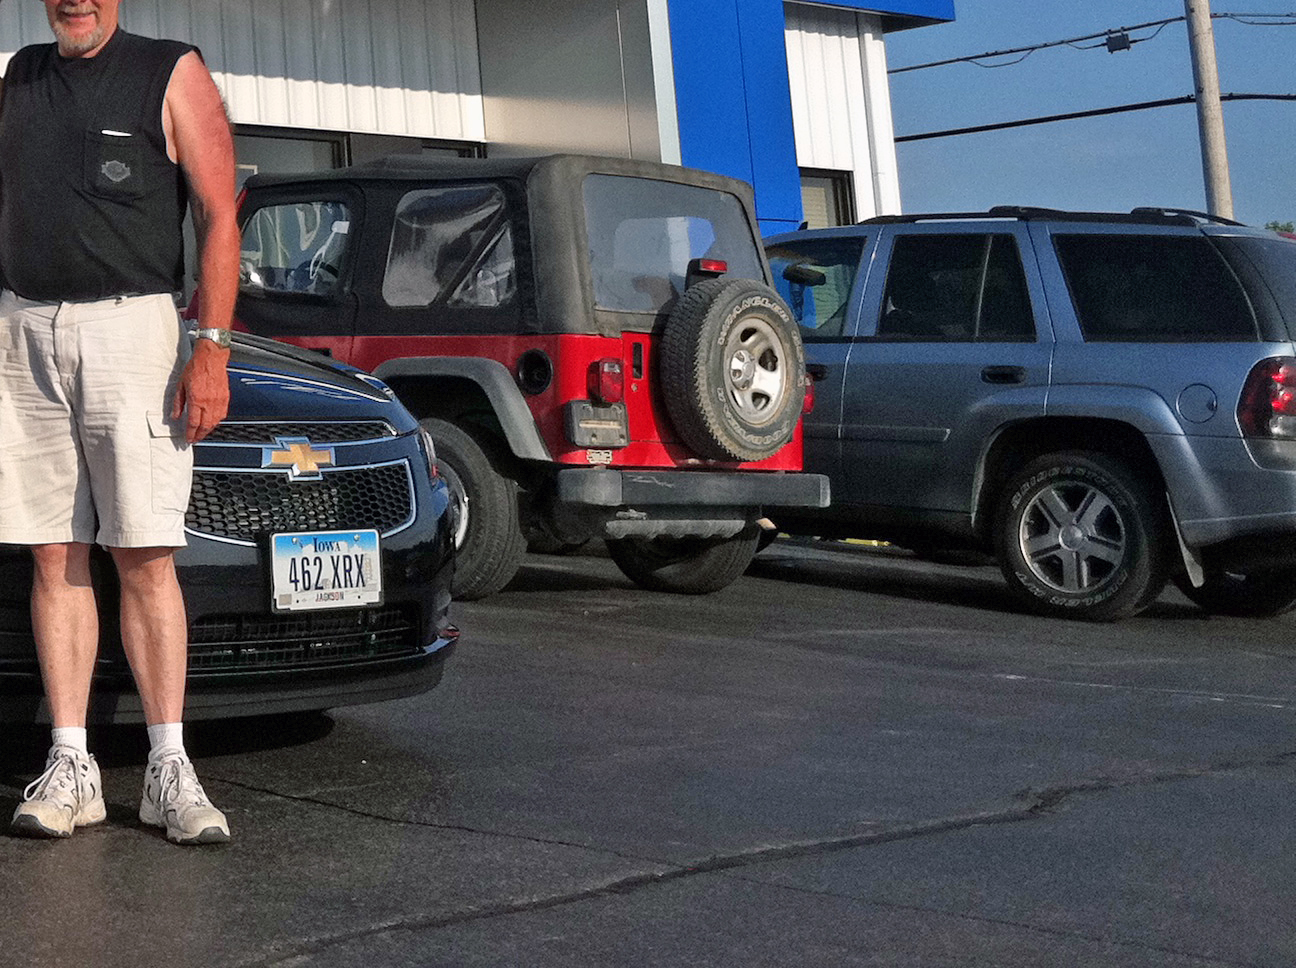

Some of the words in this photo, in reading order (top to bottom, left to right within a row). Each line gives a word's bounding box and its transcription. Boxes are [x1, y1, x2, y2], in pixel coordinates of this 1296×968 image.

[289, 556, 324, 592] 462
[330, 553, 366, 590] XRX
[315, 591, 345, 603] JACKSON
